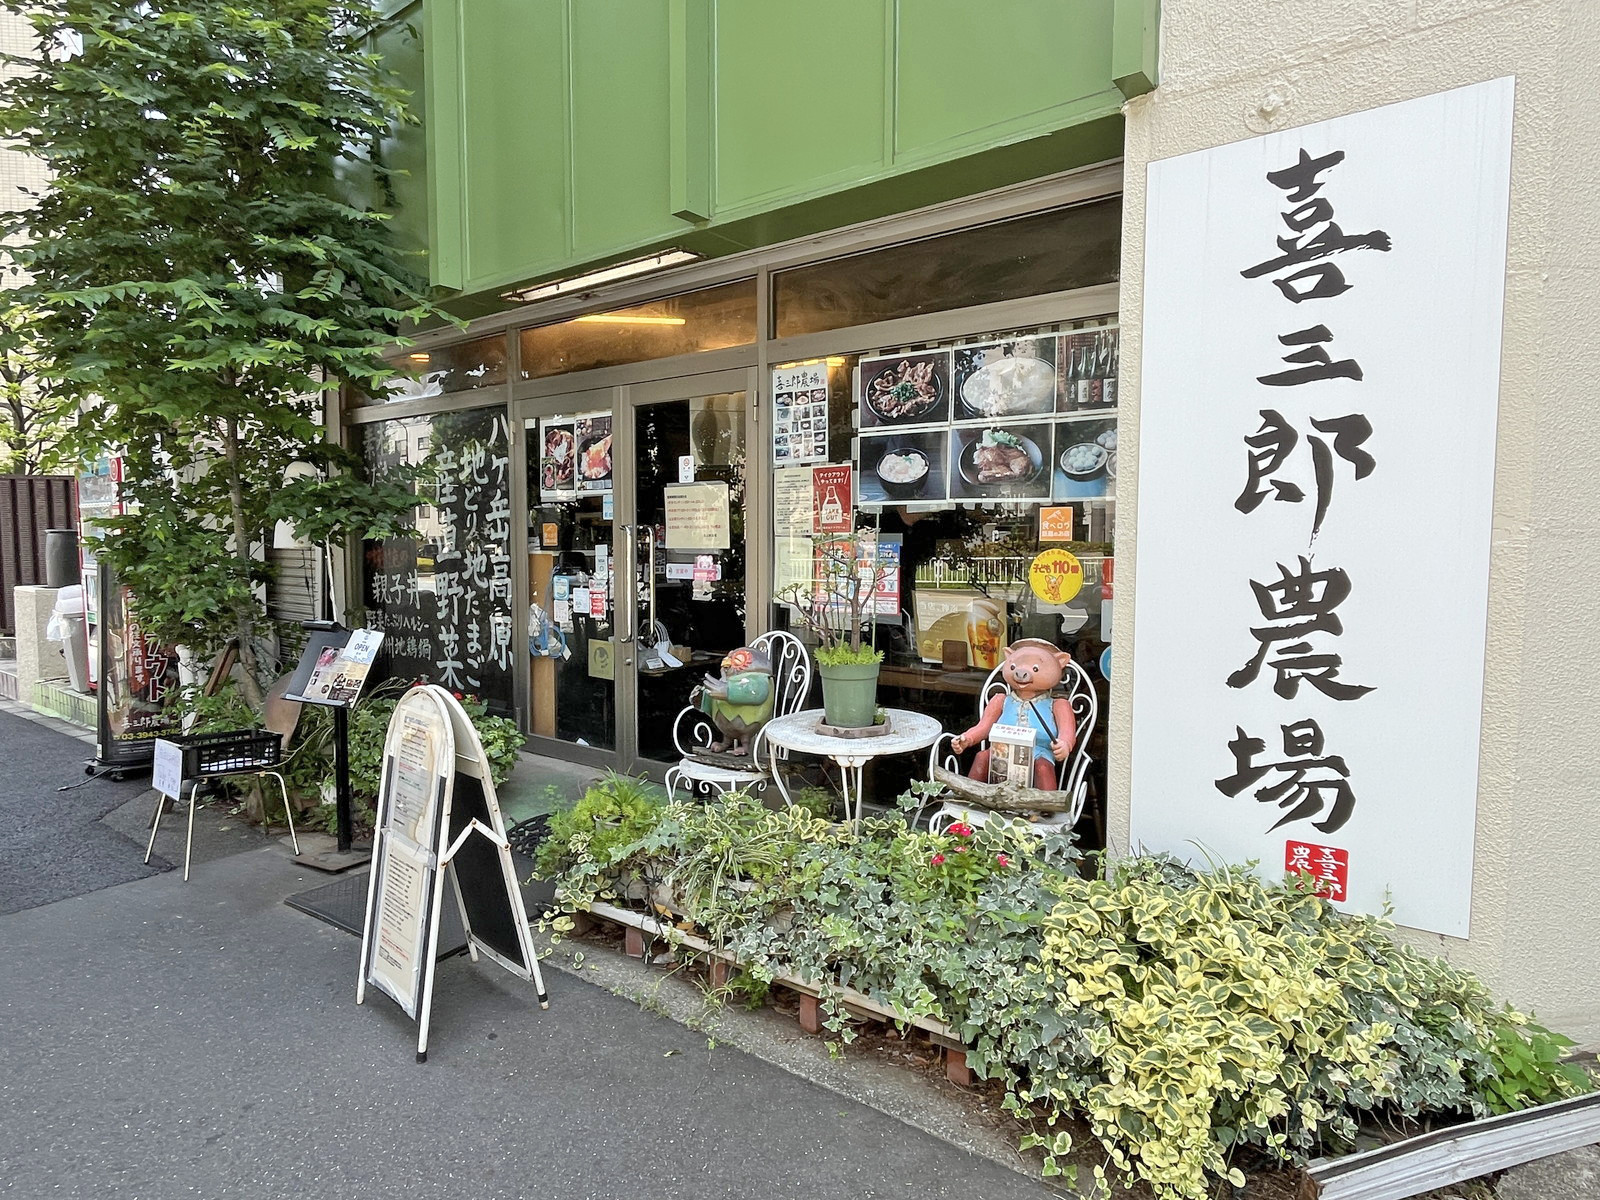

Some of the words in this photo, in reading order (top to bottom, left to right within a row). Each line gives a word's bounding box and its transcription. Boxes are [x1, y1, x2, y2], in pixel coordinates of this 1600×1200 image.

[775, 371, 820, 391] 喜三郎農場
[1214, 147, 1393, 835] 喜三郎農場
[435, 444, 465, 691] 産直野菜
[372, 569, 421, 610] 親子丼
[354, 643, 369, 653] OPEN
